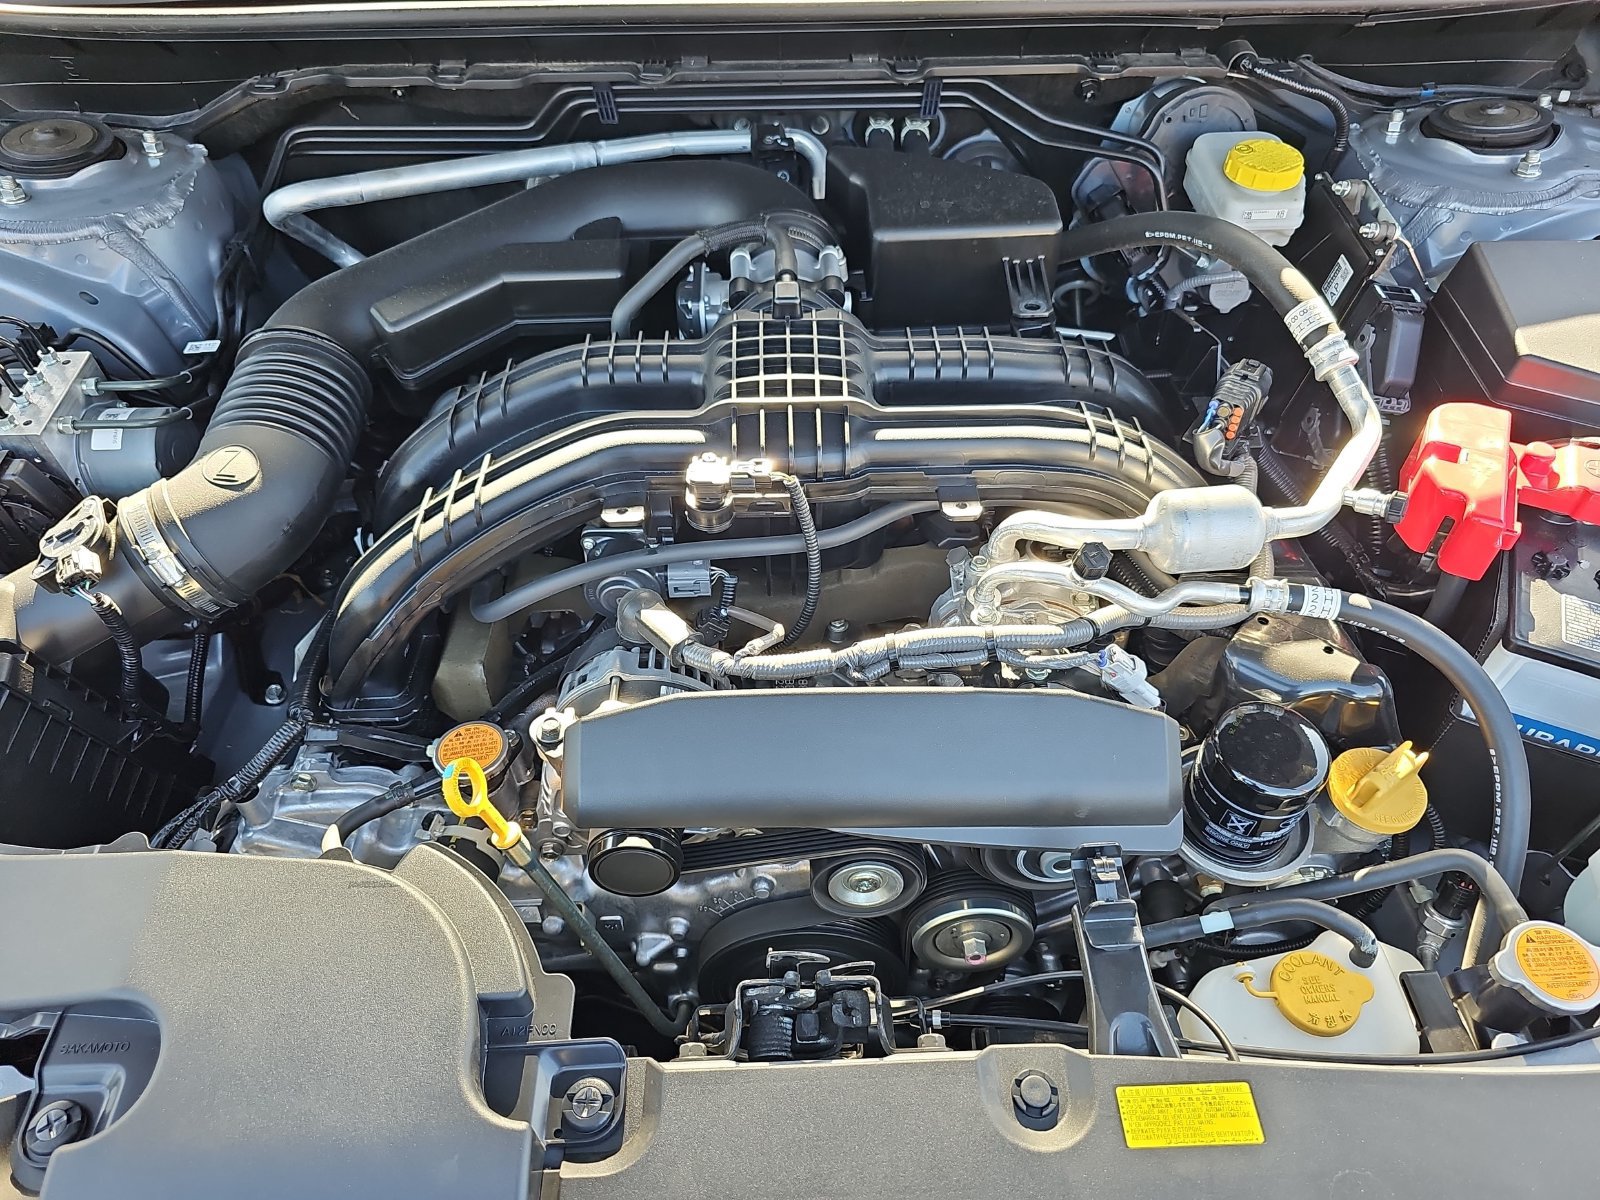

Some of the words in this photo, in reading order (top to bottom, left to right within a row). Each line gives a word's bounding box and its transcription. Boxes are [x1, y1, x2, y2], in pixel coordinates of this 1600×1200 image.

[1279, 954, 1345, 981] COOLANT
[1301, 975, 1322, 985] SEE
[1300, 983, 1336, 995] OWNERS
[1303, 993, 1341, 1005] MANUAL
[60, 1041, 131, 1056] SAKAMOTO
